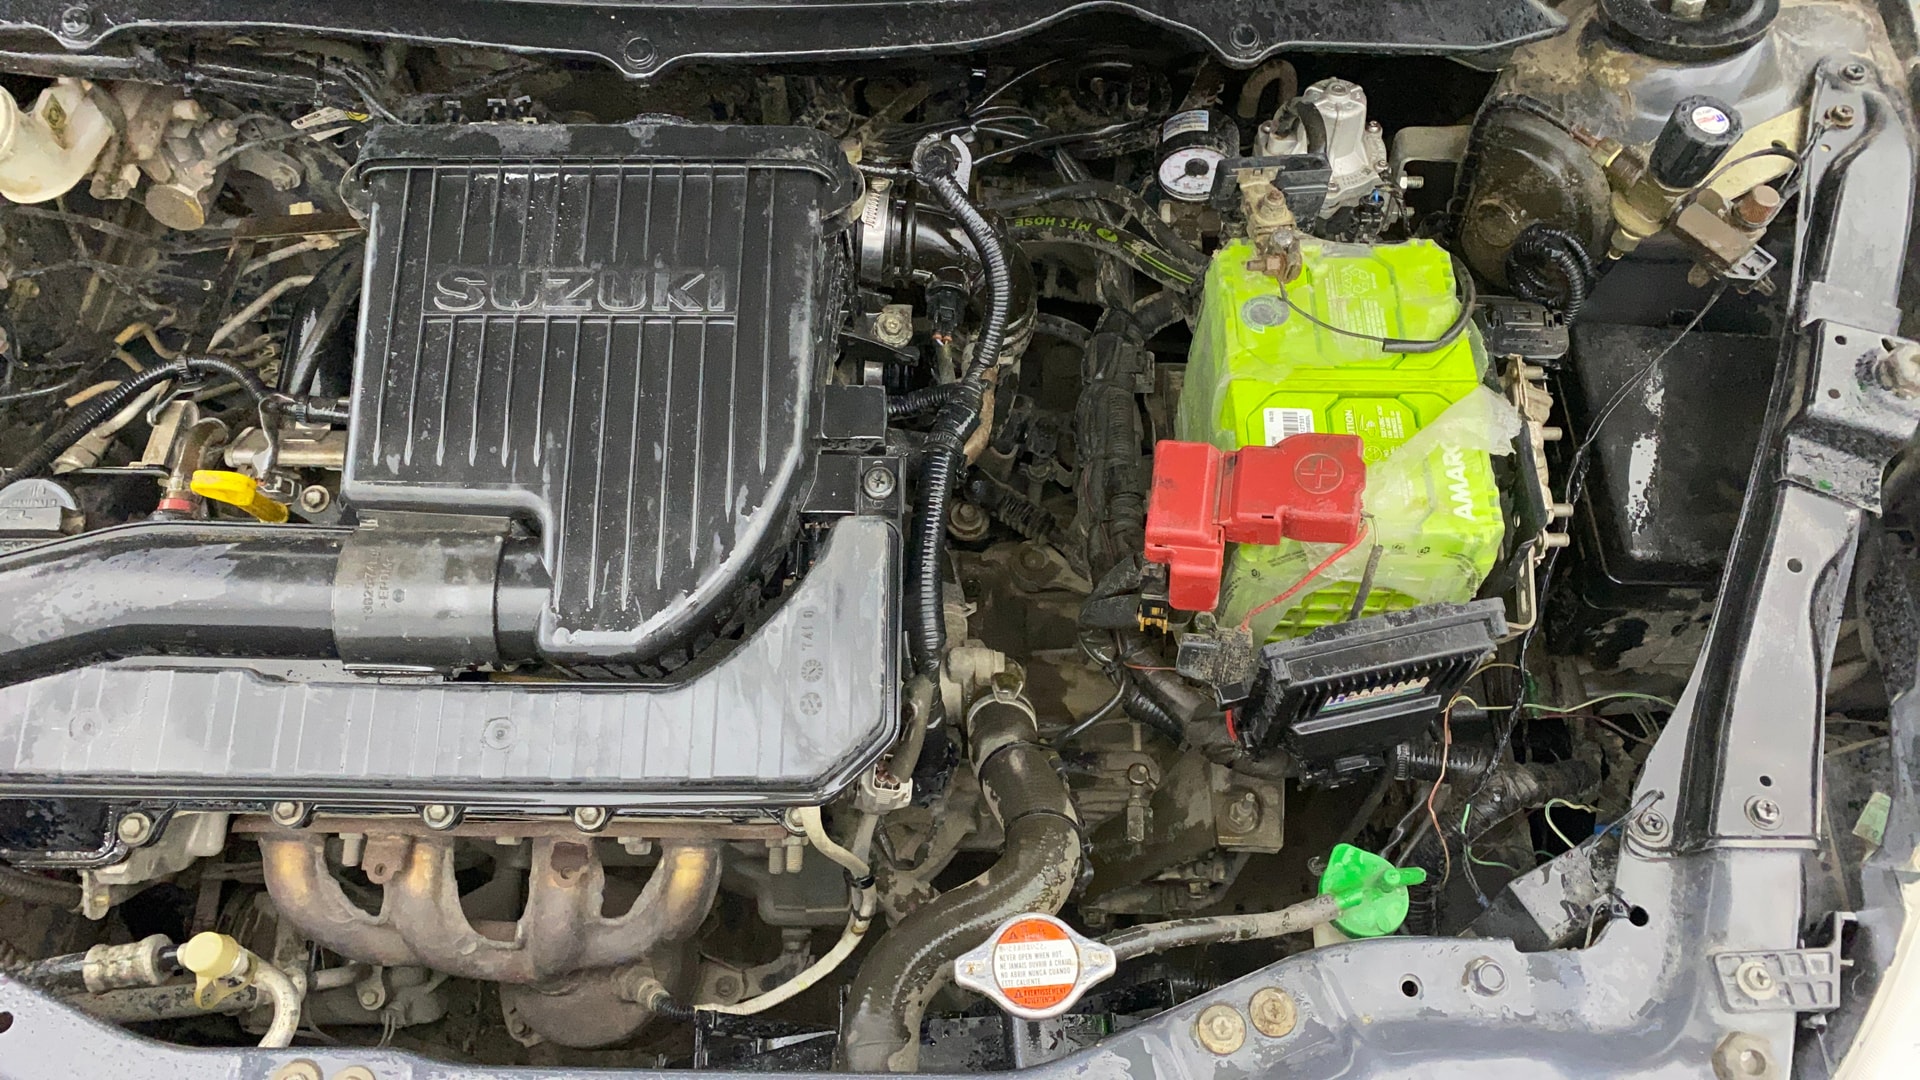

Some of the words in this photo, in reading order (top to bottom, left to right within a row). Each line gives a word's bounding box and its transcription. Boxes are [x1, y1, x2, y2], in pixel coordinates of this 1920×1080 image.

[1014, 216, 1056, 227] HOSE
[1059, 217, 1092, 232] MFS
[433, 269, 726, 312] SUZUKI
[1345, 410, 1354, 436] UTION
[999, 953, 1016, 962] NEVER
[1018, 952, 1032, 961] OPEN
[1034, 951, 1049, 959] WHEN
[999, 962, 1006, 970] NE
[1008, 961, 1027, 969] JAMAIS
[1028, 960, 1047, 968] OUVRIR
[1000, 971, 1008, 979] NO
[1010, 970, 1026, 978] ABRIR
[1028, 969, 1047, 977] NUNCA
[1048, 967, 1071, 976] CUANDO
[1016, 978, 1041, 986] CALIENTE
